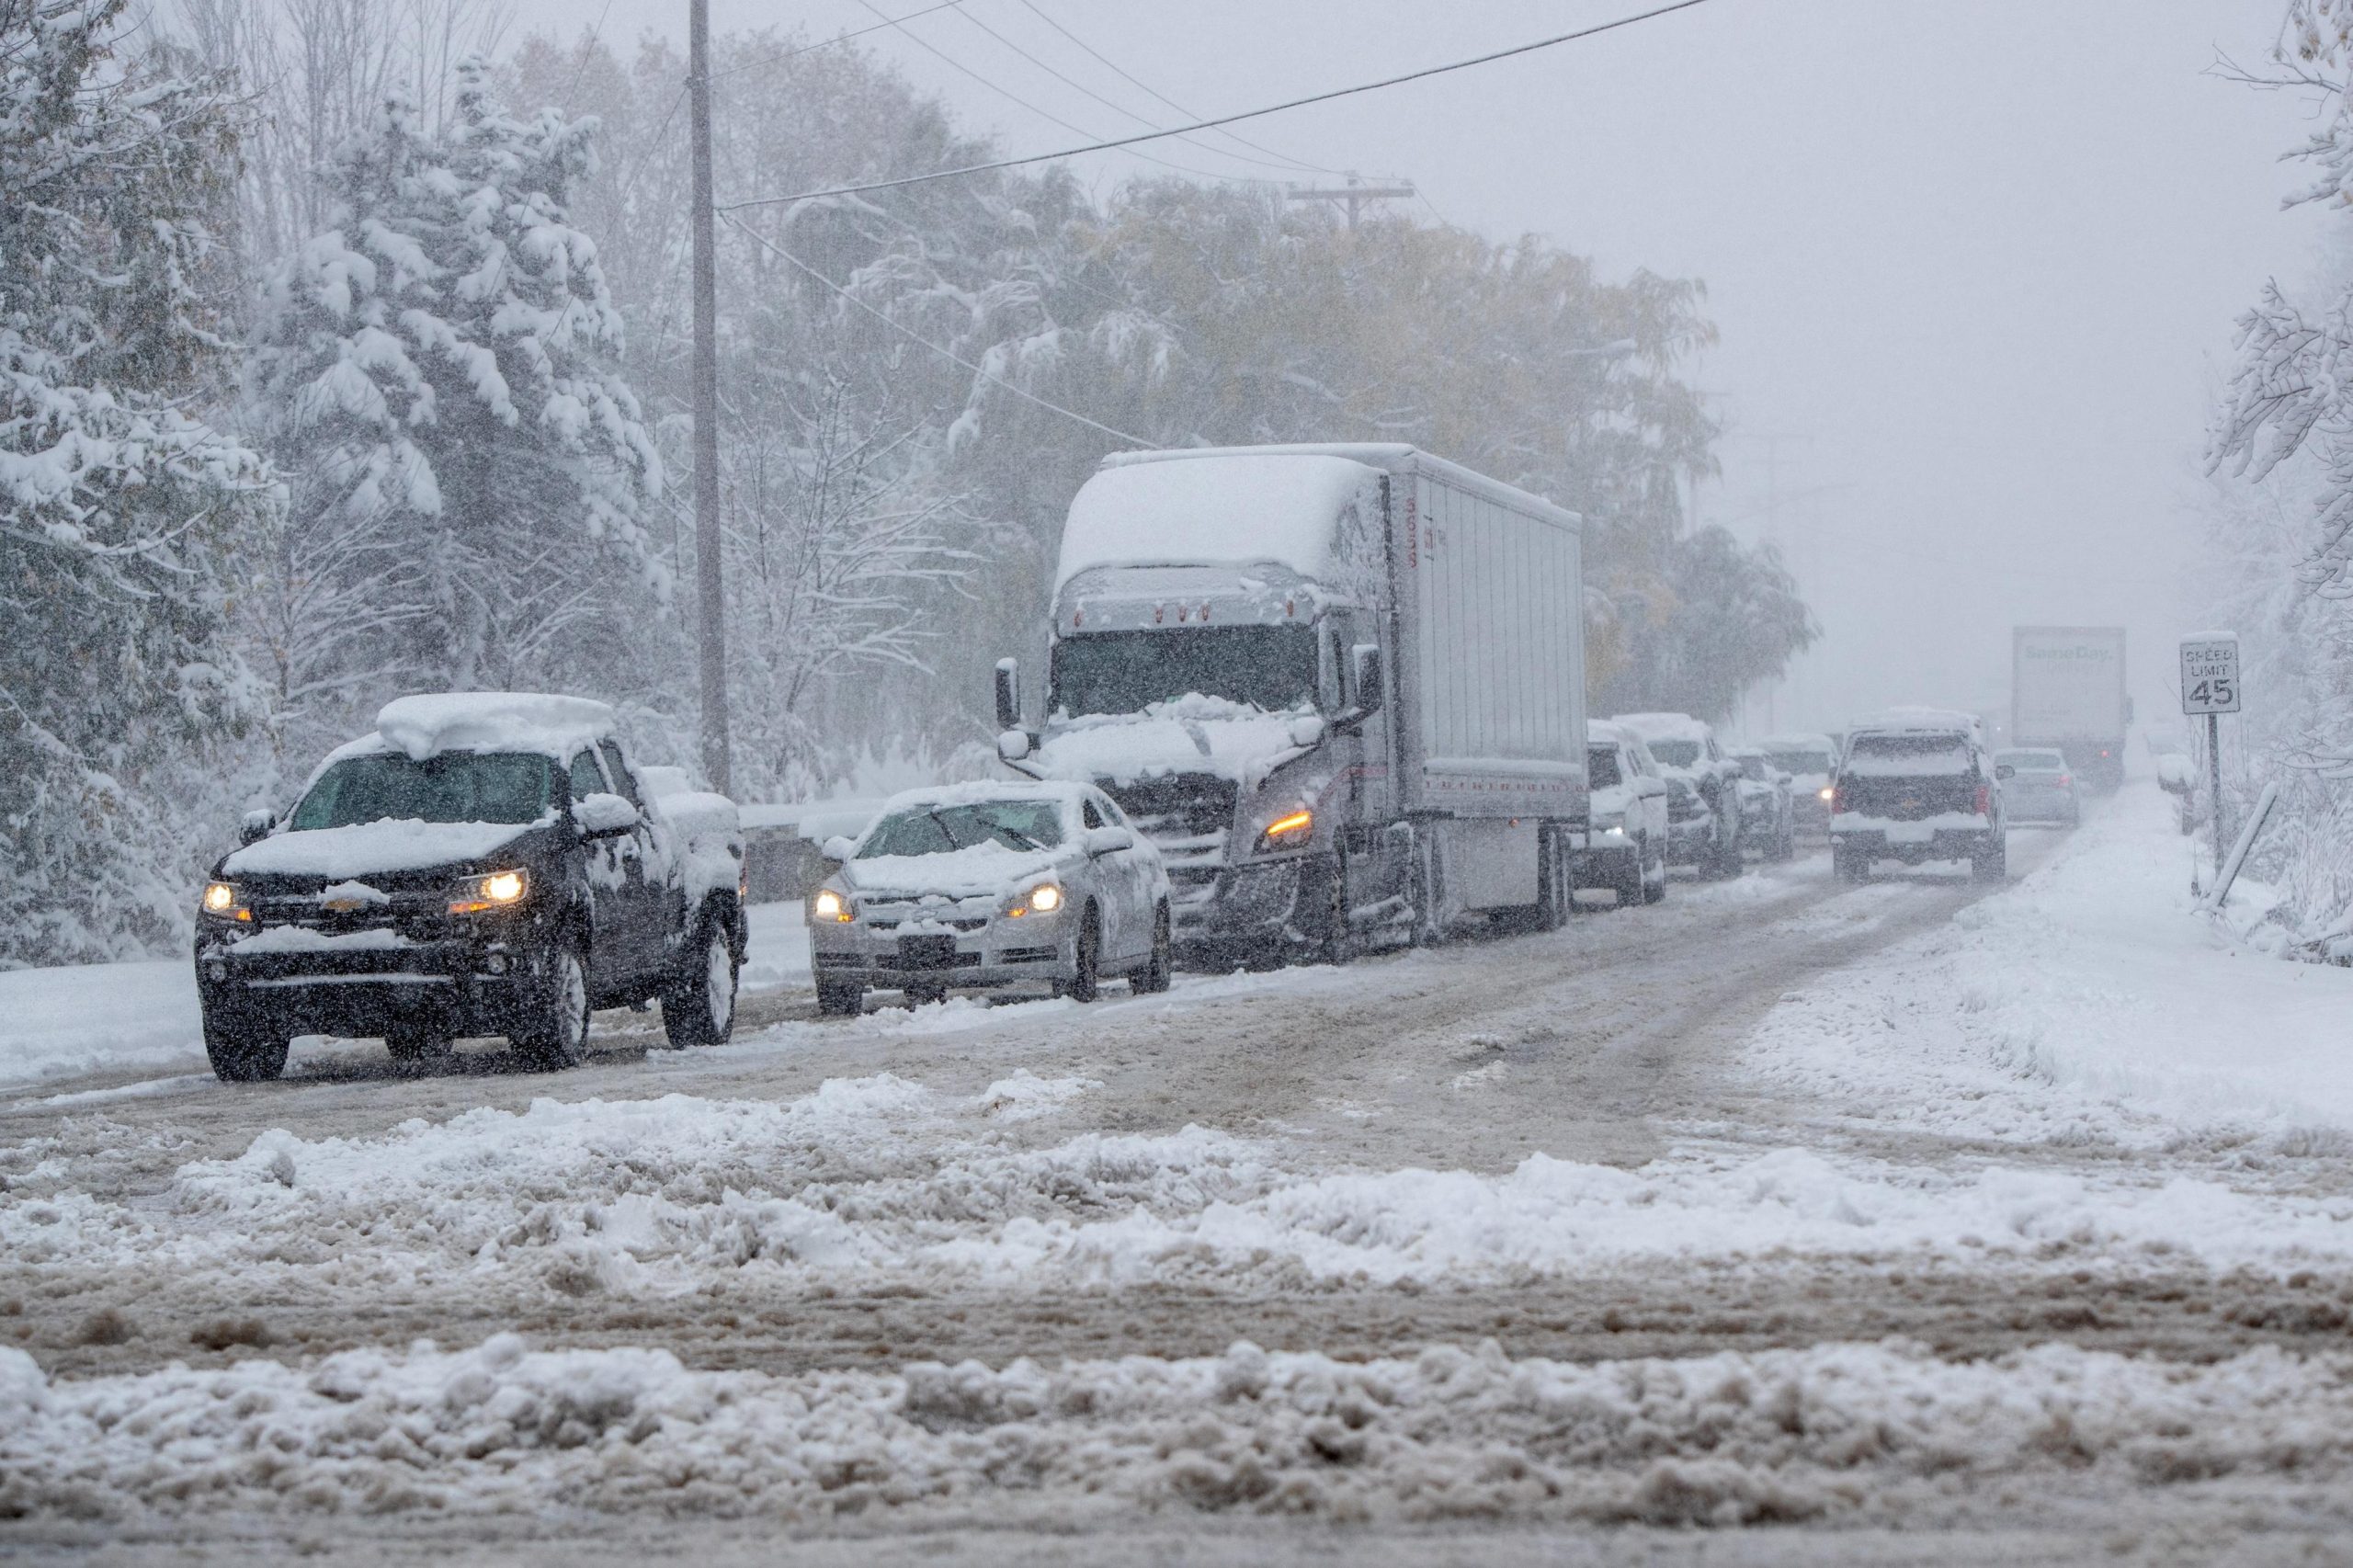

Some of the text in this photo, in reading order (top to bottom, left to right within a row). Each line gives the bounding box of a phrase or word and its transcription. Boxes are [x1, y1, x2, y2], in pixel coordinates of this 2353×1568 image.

[2186, 649, 2233, 662] SPEED
[2191, 665, 2228, 676] LIMIT
[2188, 679, 2234, 705] 45
